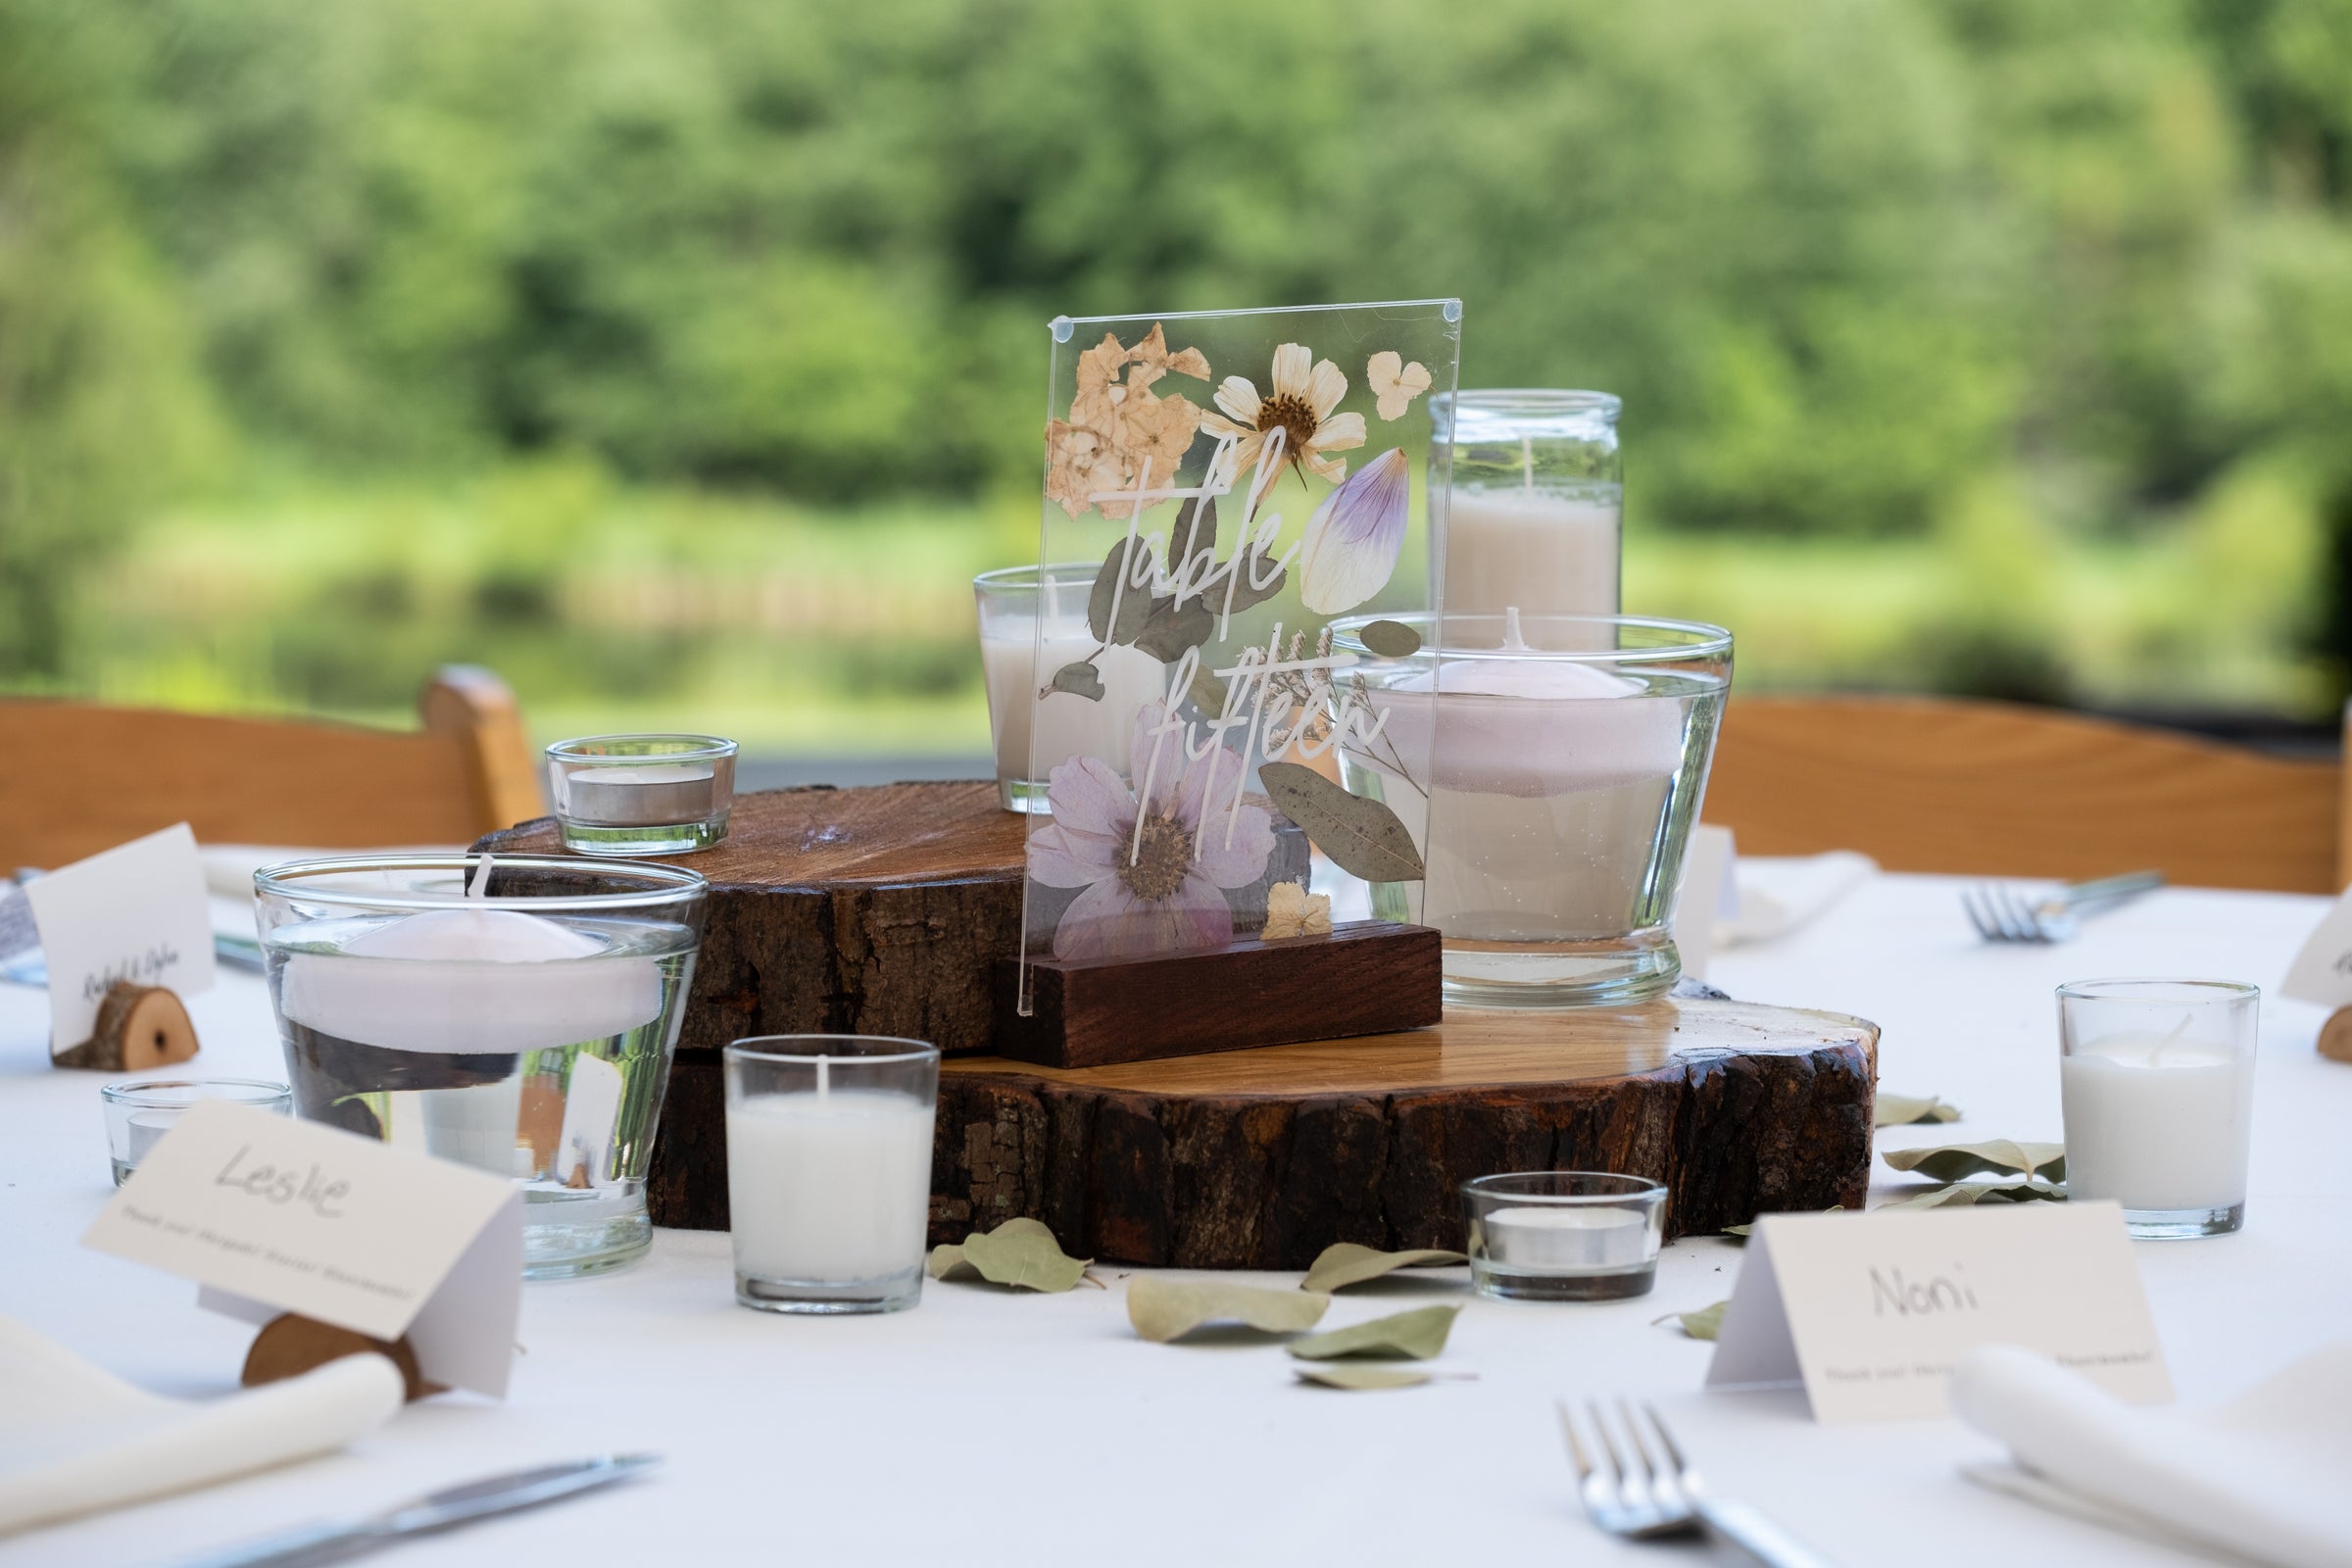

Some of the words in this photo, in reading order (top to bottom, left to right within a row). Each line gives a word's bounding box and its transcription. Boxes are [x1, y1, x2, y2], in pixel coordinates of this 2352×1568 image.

[1089, 425, 1300, 684] table
[1129, 621, 1391, 866] fifteen
[213, 1141, 353, 1220] Leslie
[1865, 1260, 1981, 1319] Noni
